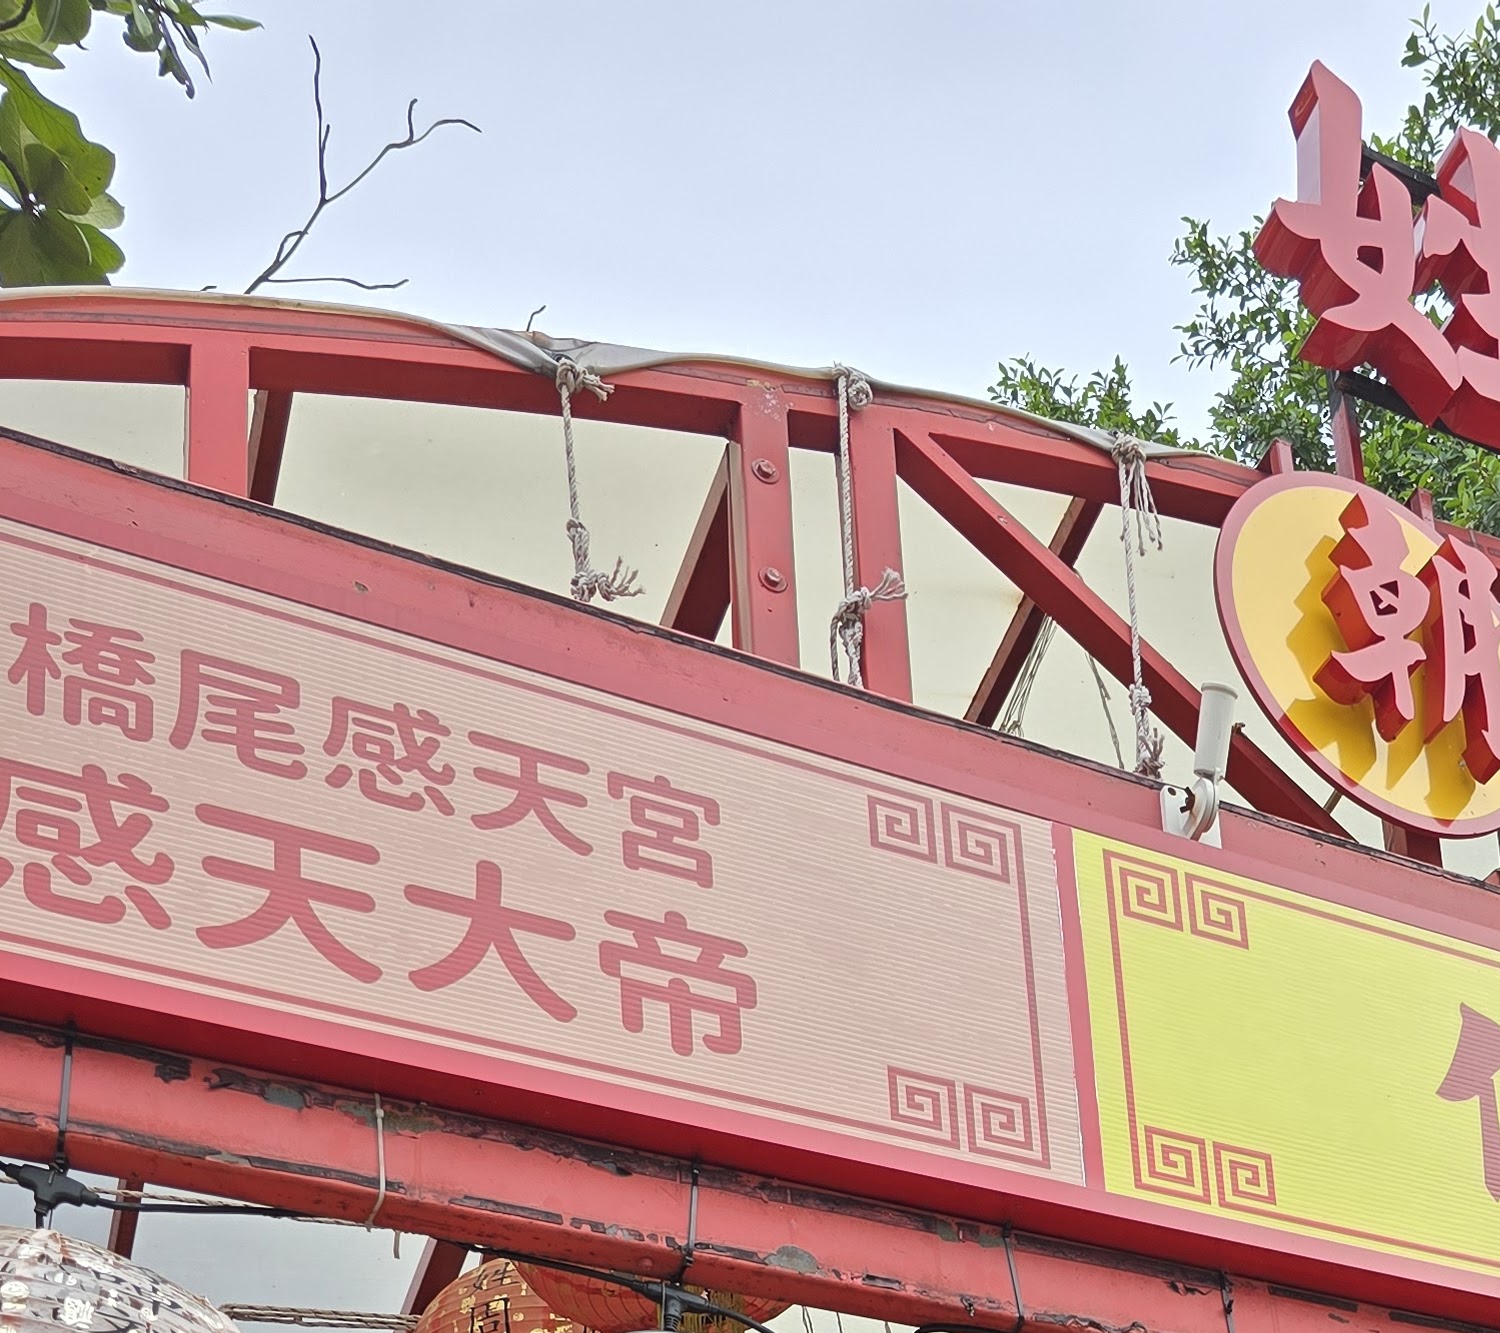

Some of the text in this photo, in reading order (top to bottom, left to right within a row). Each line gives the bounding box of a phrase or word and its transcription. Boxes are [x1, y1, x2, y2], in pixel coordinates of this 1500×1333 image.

[7, 602, 720, 889] 橋尾感天宮
[0, 762, 758, 1058] 感天大帝
